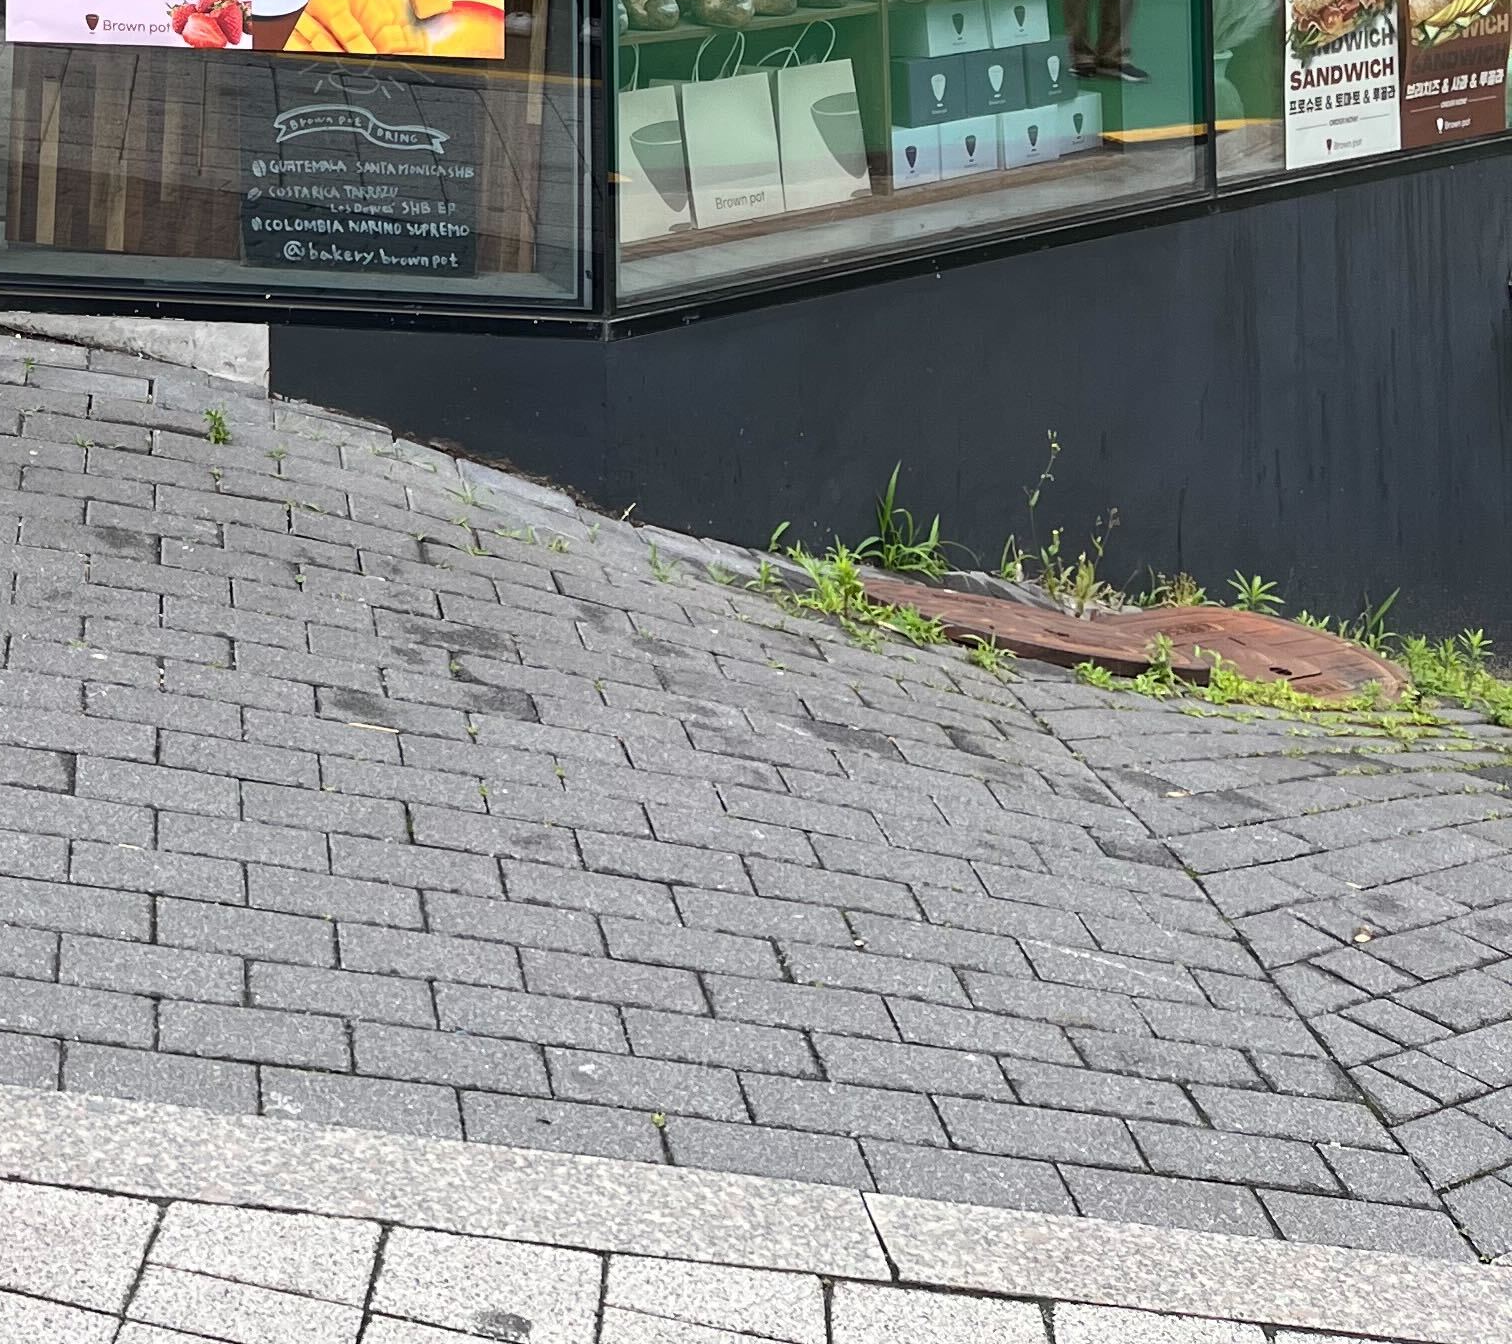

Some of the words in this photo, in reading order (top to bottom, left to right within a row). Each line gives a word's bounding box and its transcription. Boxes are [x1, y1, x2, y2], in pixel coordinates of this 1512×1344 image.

[103, 18, 152, 34] Brown
[155, 18, 172, 37] pot
[1290, 57, 1395, 92] SANDWICH
[1289, 95, 1323, 115] 프로슈토
[1325, 94, 1333, 110] &
[1335, 90, 1361, 108] 토마토
[1363, 89, 1370, 103] &
[1372, 85, 1396, 102] 루꼴라
[290, 116, 333, 131] Brown
[338, 115, 362, 128] pot
[269, 160, 347, 174] GUATEMALA
[356, 162, 395, 175] SANTA
[397, 164, 447, 177] MONICA
[447, 166, 475, 178] SHB
[402, 201, 431, 215] SHB
[715, 193, 745, 211] Brown
[746, 190, 766, 209] pot
[265, 216, 344, 234] COLOMBIA
[406, 221, 470, 238] SUPREMO
